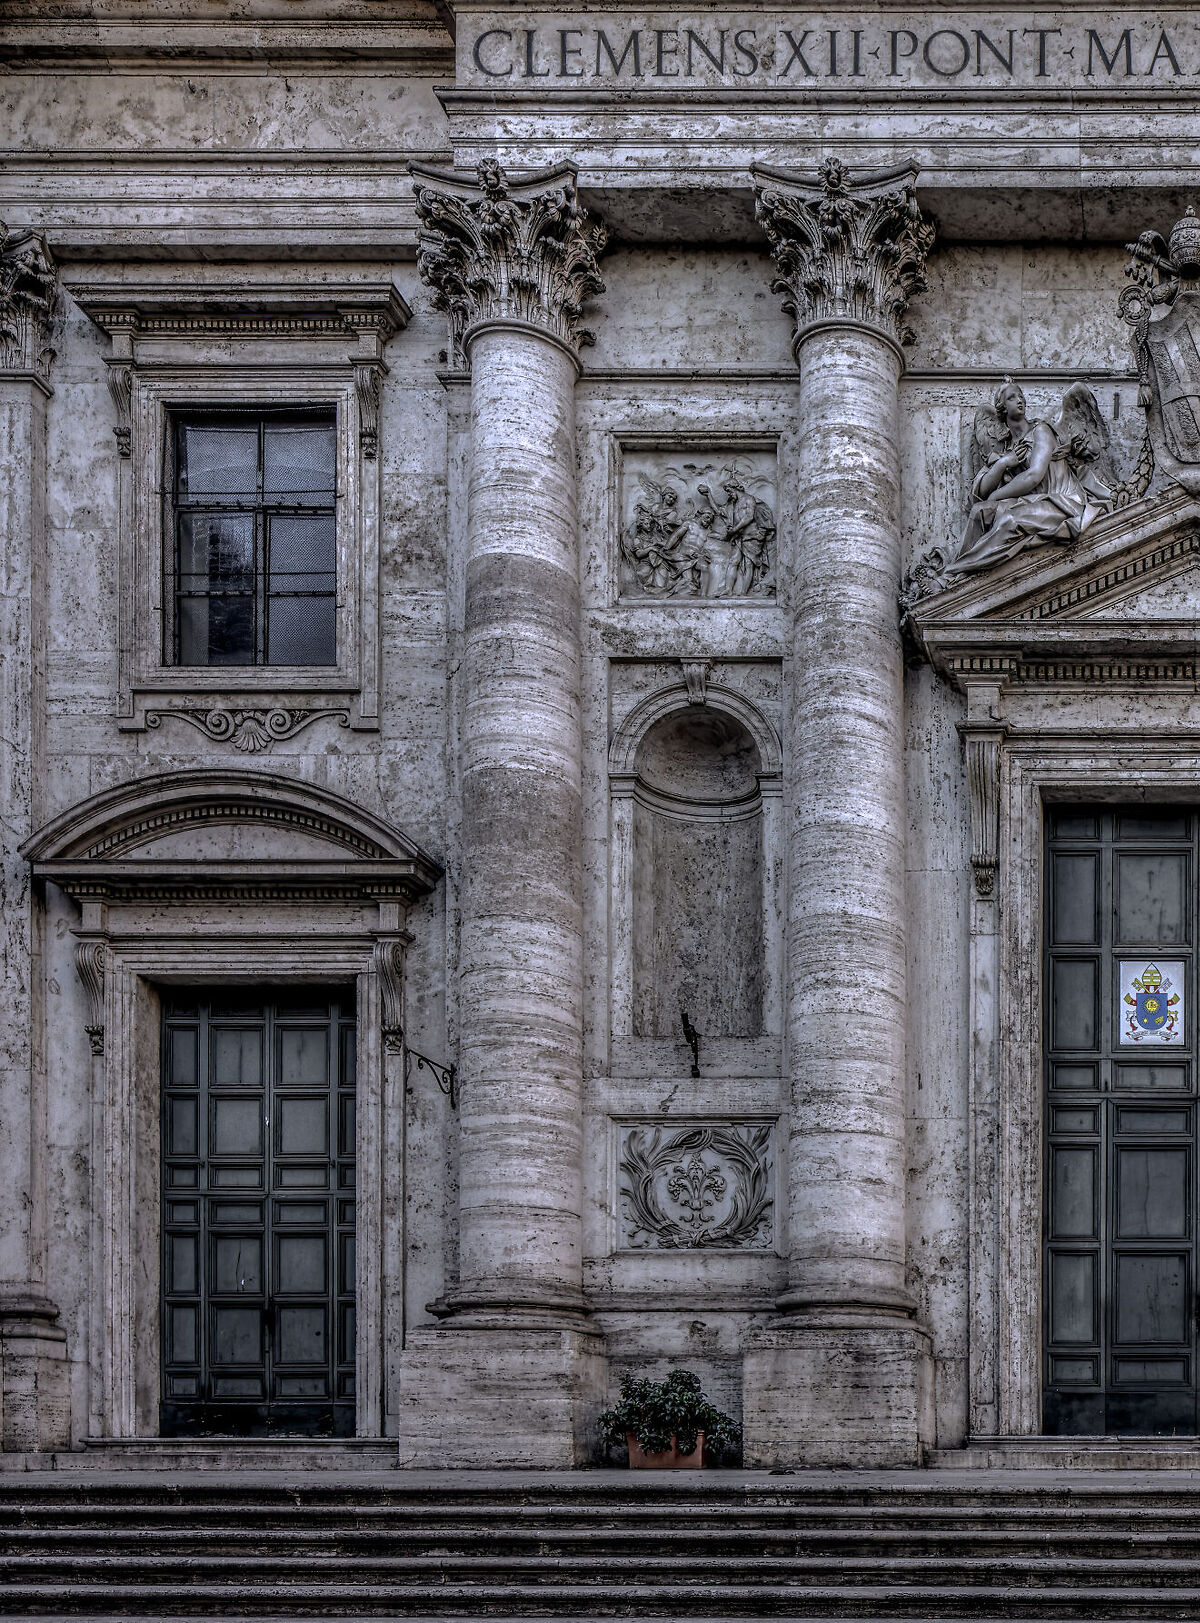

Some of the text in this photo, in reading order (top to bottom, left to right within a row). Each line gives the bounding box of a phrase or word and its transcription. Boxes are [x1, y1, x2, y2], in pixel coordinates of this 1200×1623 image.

[472, 28, 760, 78] CLEMENS
[776, 29, 862, 77] XII
[886, 28, 1064, 77] PONT
